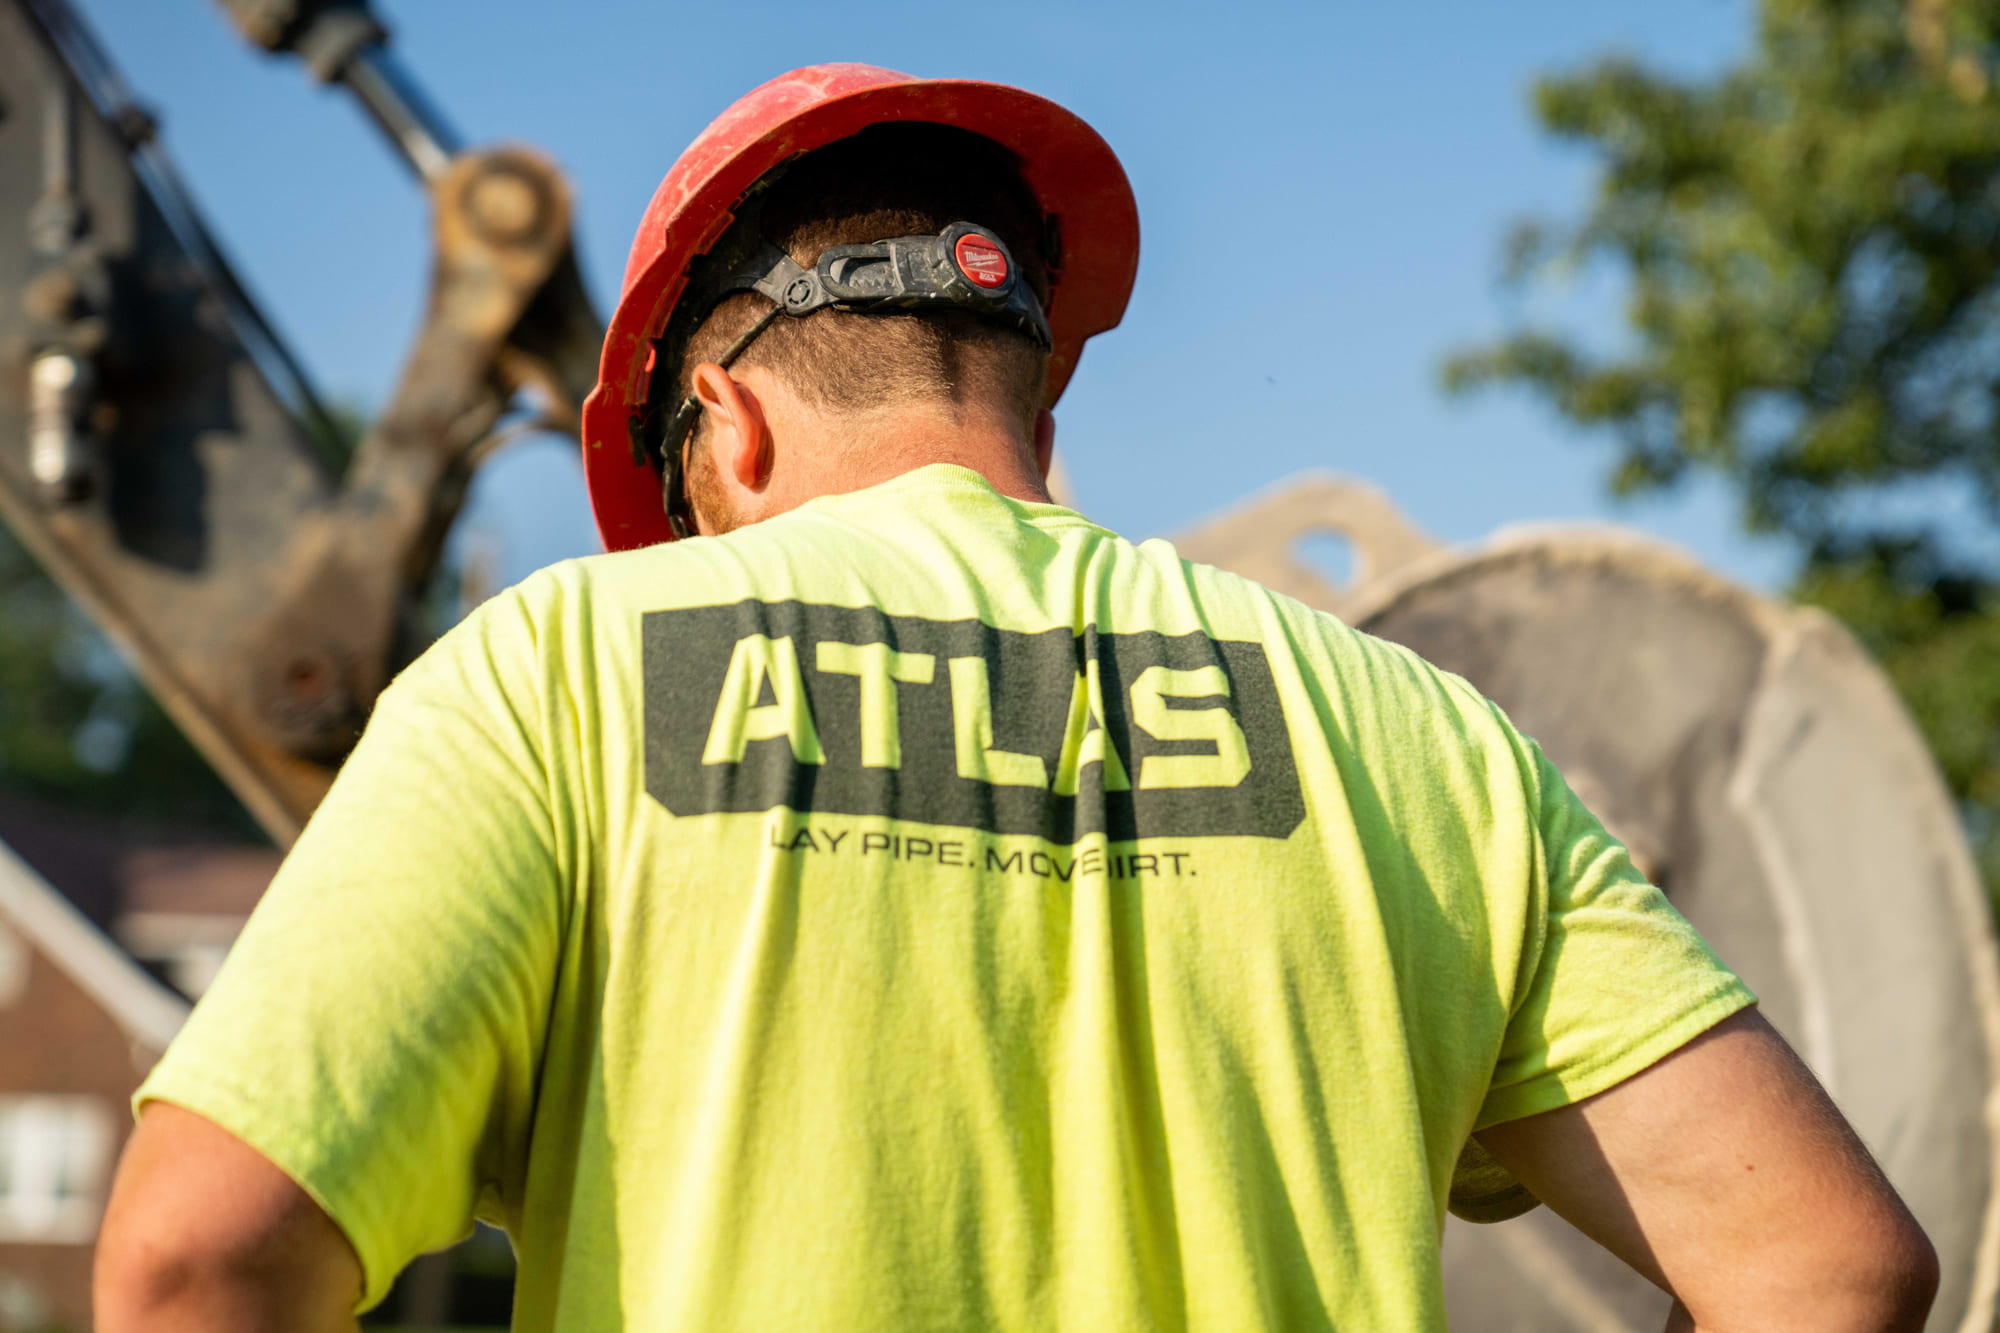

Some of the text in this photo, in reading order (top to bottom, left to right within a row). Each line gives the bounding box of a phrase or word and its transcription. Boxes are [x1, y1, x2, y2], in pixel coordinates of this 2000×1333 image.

[702, 633, 1252, 796] ATLAS
[771, 823, 848, 853] LAY
[863, 832, 975, 867] PIPE.
[1107, 852, 1197, 880] IRT.
